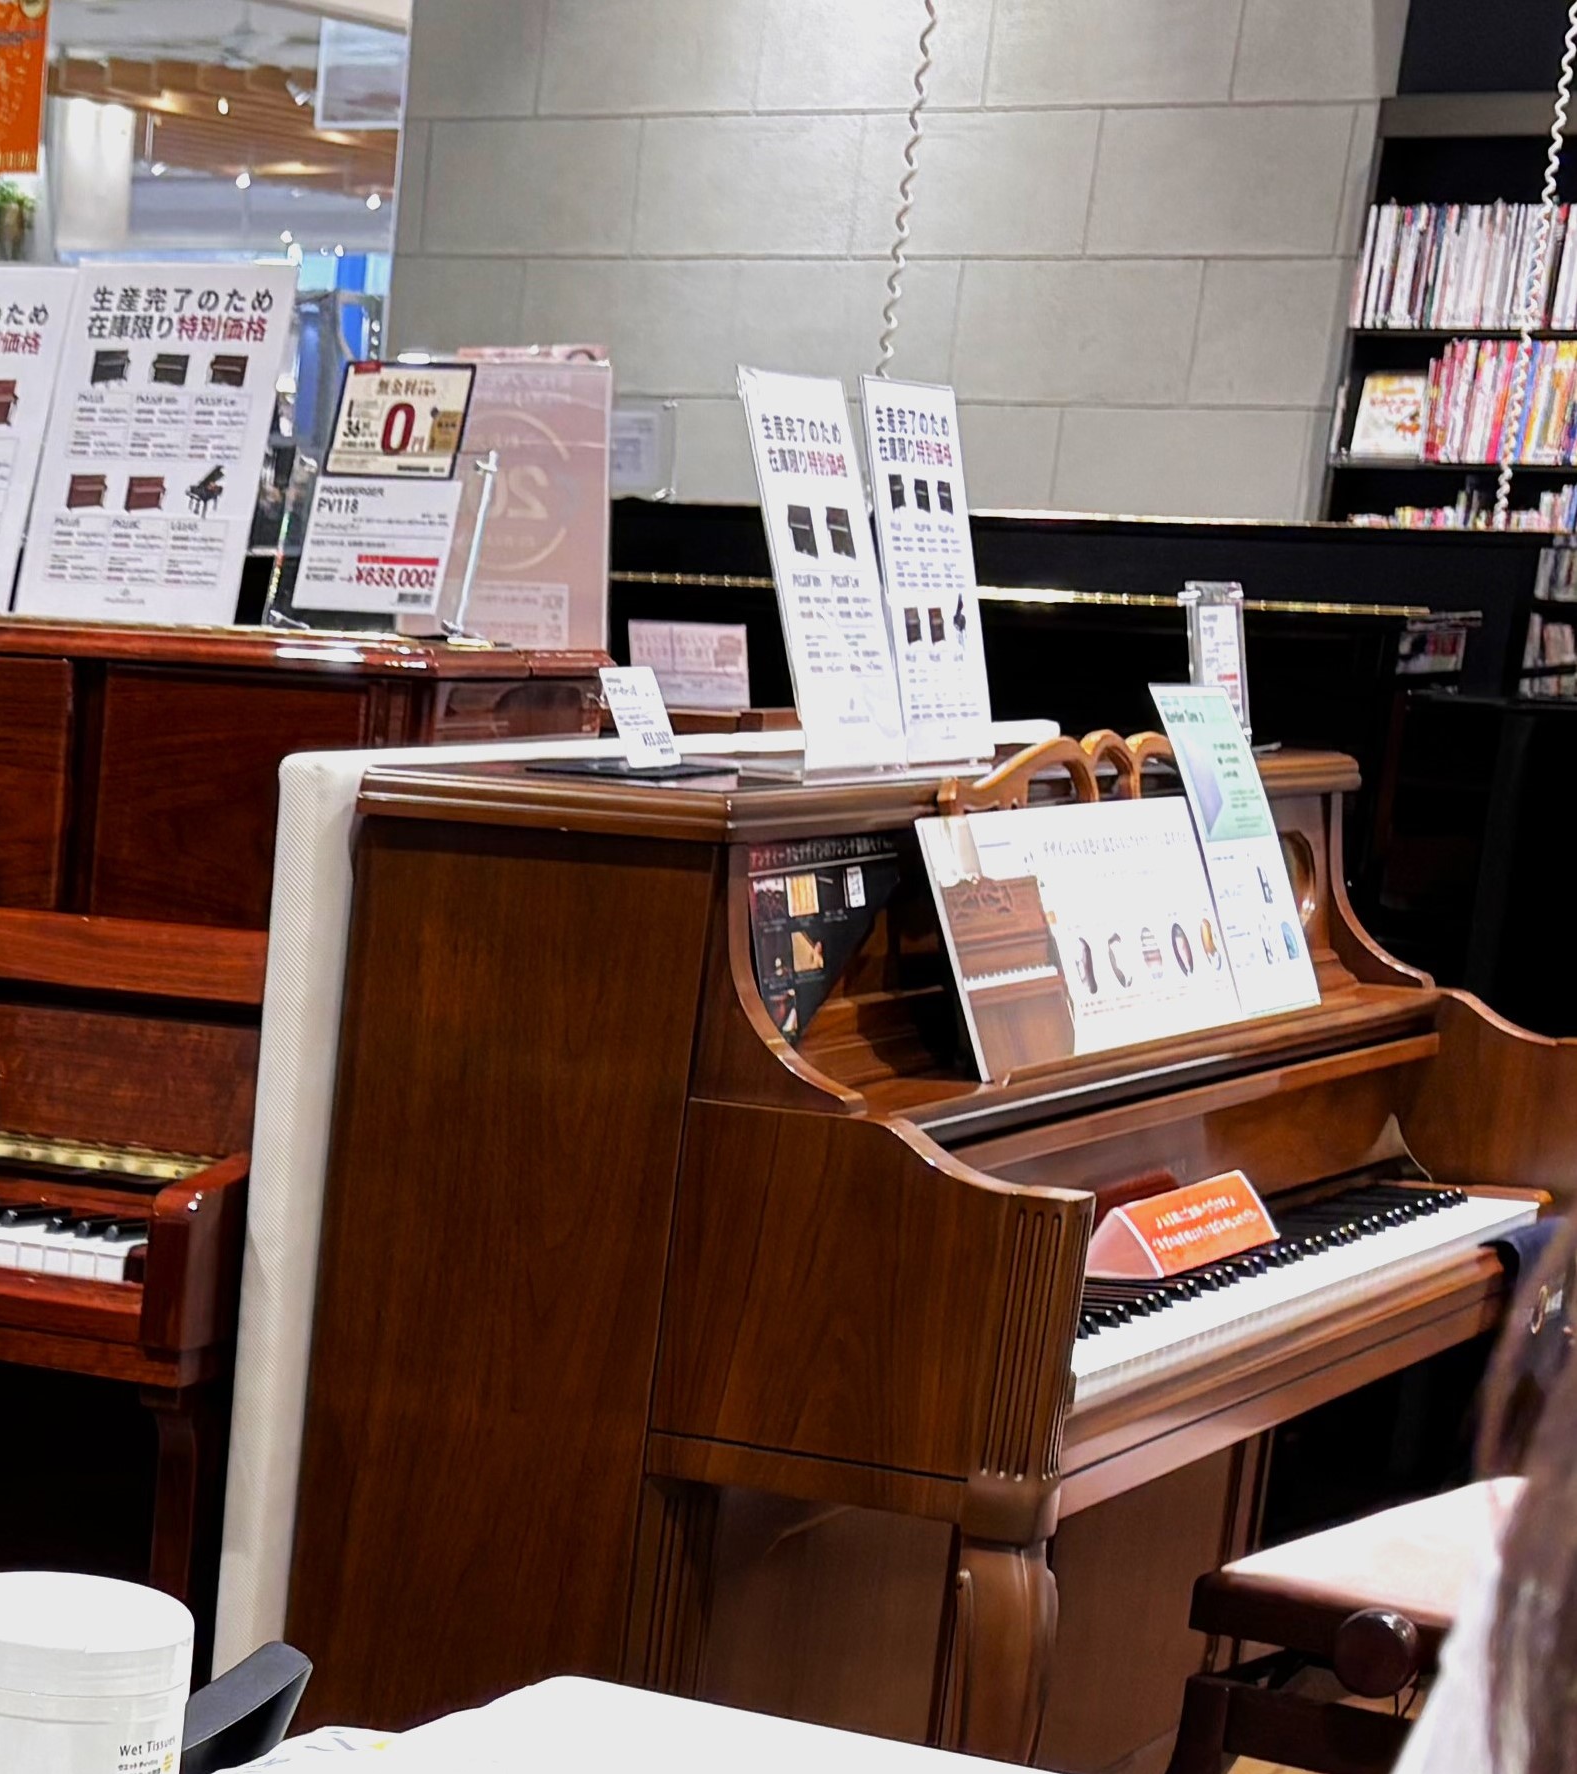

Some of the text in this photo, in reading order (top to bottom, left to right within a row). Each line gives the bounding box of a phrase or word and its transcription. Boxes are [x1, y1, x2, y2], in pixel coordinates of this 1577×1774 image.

[90, 285, 273, 313] 生産完了のため
[87, 314, 268, 342] 在庫限り特別価格
[761, 413, 843, 444] 生産完了のため
[875, 404, 950, 437] 生産完了のため
[878, 436, 953, 467] 在庫限り特別価格
[317, 498, 359, 513] PV118
[119, 1744, 142, 1757] Wet
